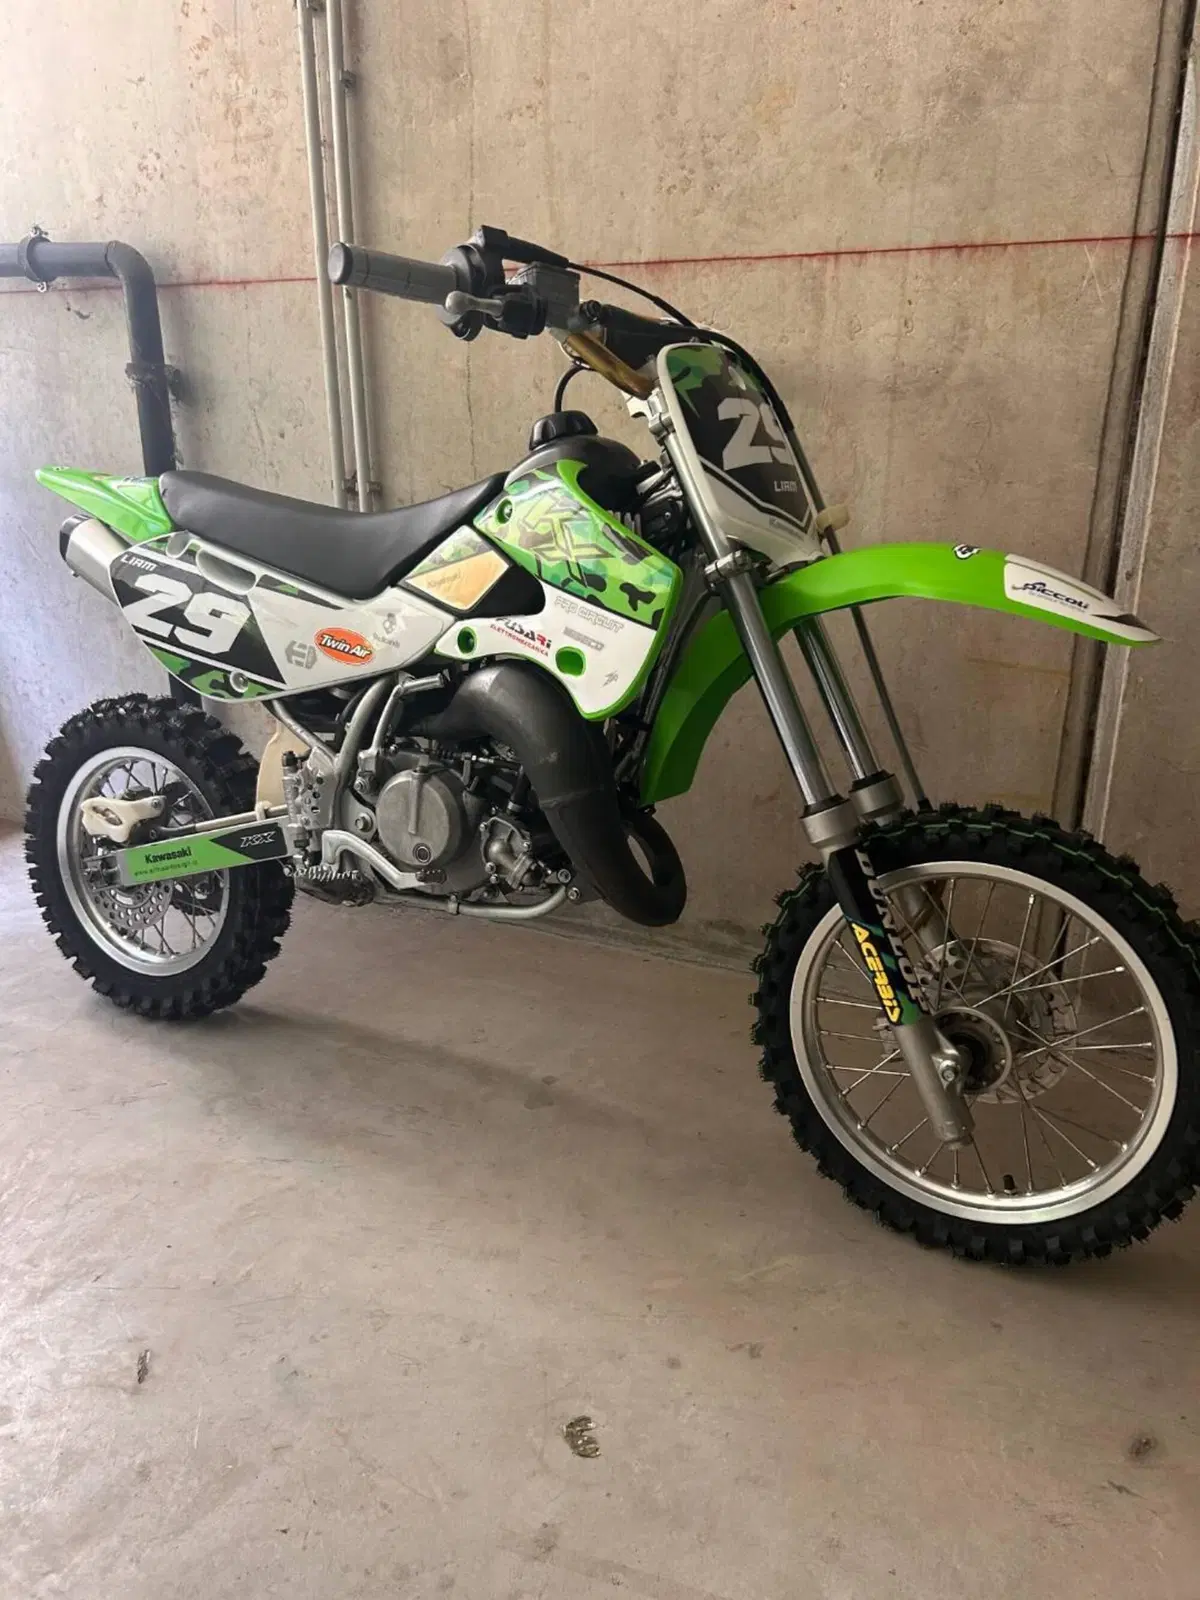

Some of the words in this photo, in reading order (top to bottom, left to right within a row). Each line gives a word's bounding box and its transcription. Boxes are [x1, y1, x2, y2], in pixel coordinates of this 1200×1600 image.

[773, 480, 798, 493] LIAM
[120, 553, 158, 572] LIAM
[123, 573, 252, 654] 29
[319, 632, 350, 654] Twin
[347, 643, 372, 660] Air
[240, 830, 276, 848] KX
[144, 846, 192, 865] Kawasaki
